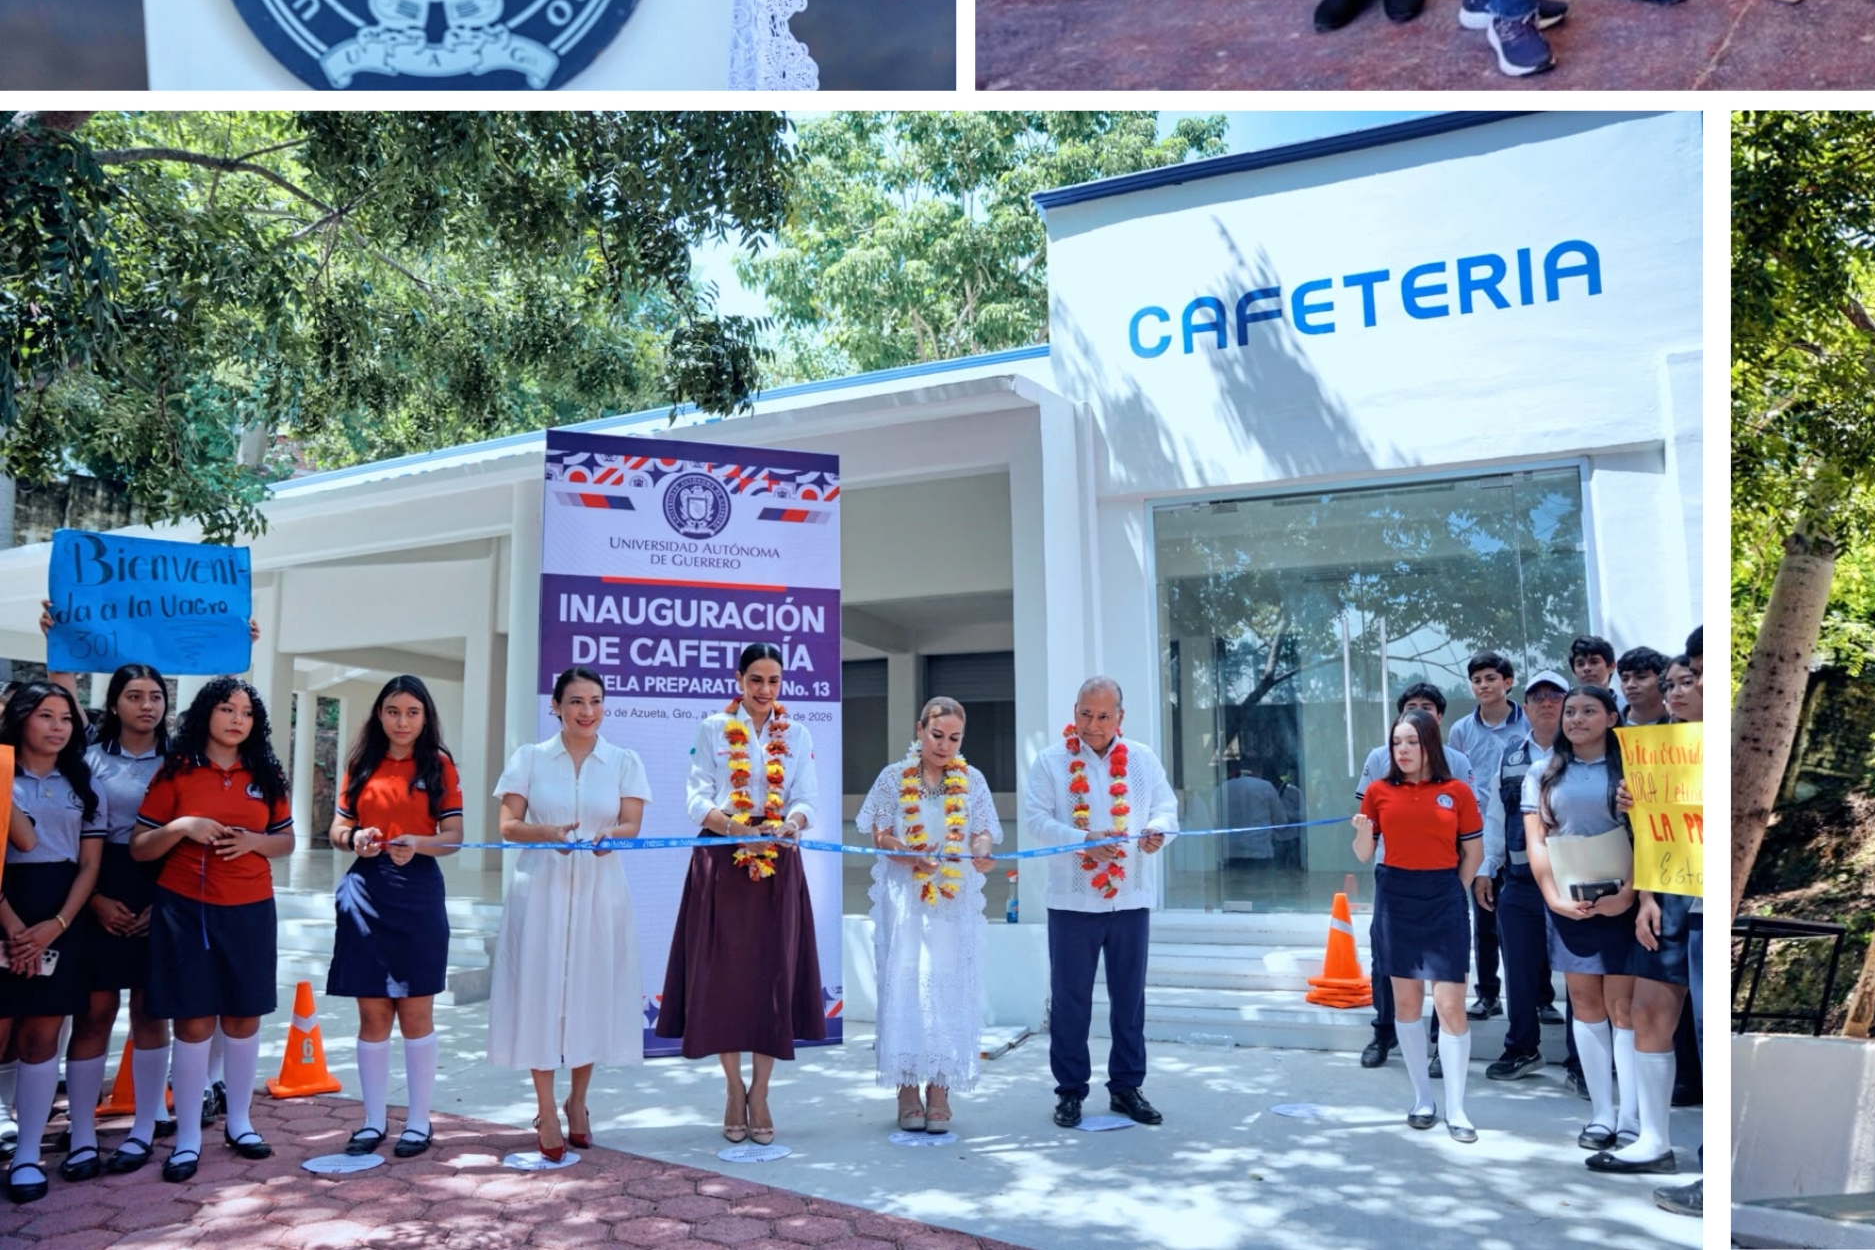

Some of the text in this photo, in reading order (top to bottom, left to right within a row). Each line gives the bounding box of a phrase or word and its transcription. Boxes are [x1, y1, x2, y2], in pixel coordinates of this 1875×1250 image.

[1128, 239, 1603, 359] CAFETERIA
[609, 536, 780, 559] UNIVERSIDAD AUTÓNOMA
[650, 553, 742, 570] DE GUERRERO
[55, 591, 92, 625] da
[100, 603, 117, 620] a
[128, 594, 151, 618] la
[559, 592, 825, 634] INAUGURACIÓN
[68, 630, 119, 660] 301
[572, 634, 815, 672] DE CAFETÍA
[782, 681, 810, 697] No.
[812, 681, 831, 697] 13
[614, 707, 628, 719] de
[630, 707, 670, 720] Azueta,
[701, 711, 708, 720] a
[792, 712, 806, 721] de
[808, 712, 833, 722] 2026
[1649, 812, 1675, 843] LA
[301, 1037, 314, 1058] 6
